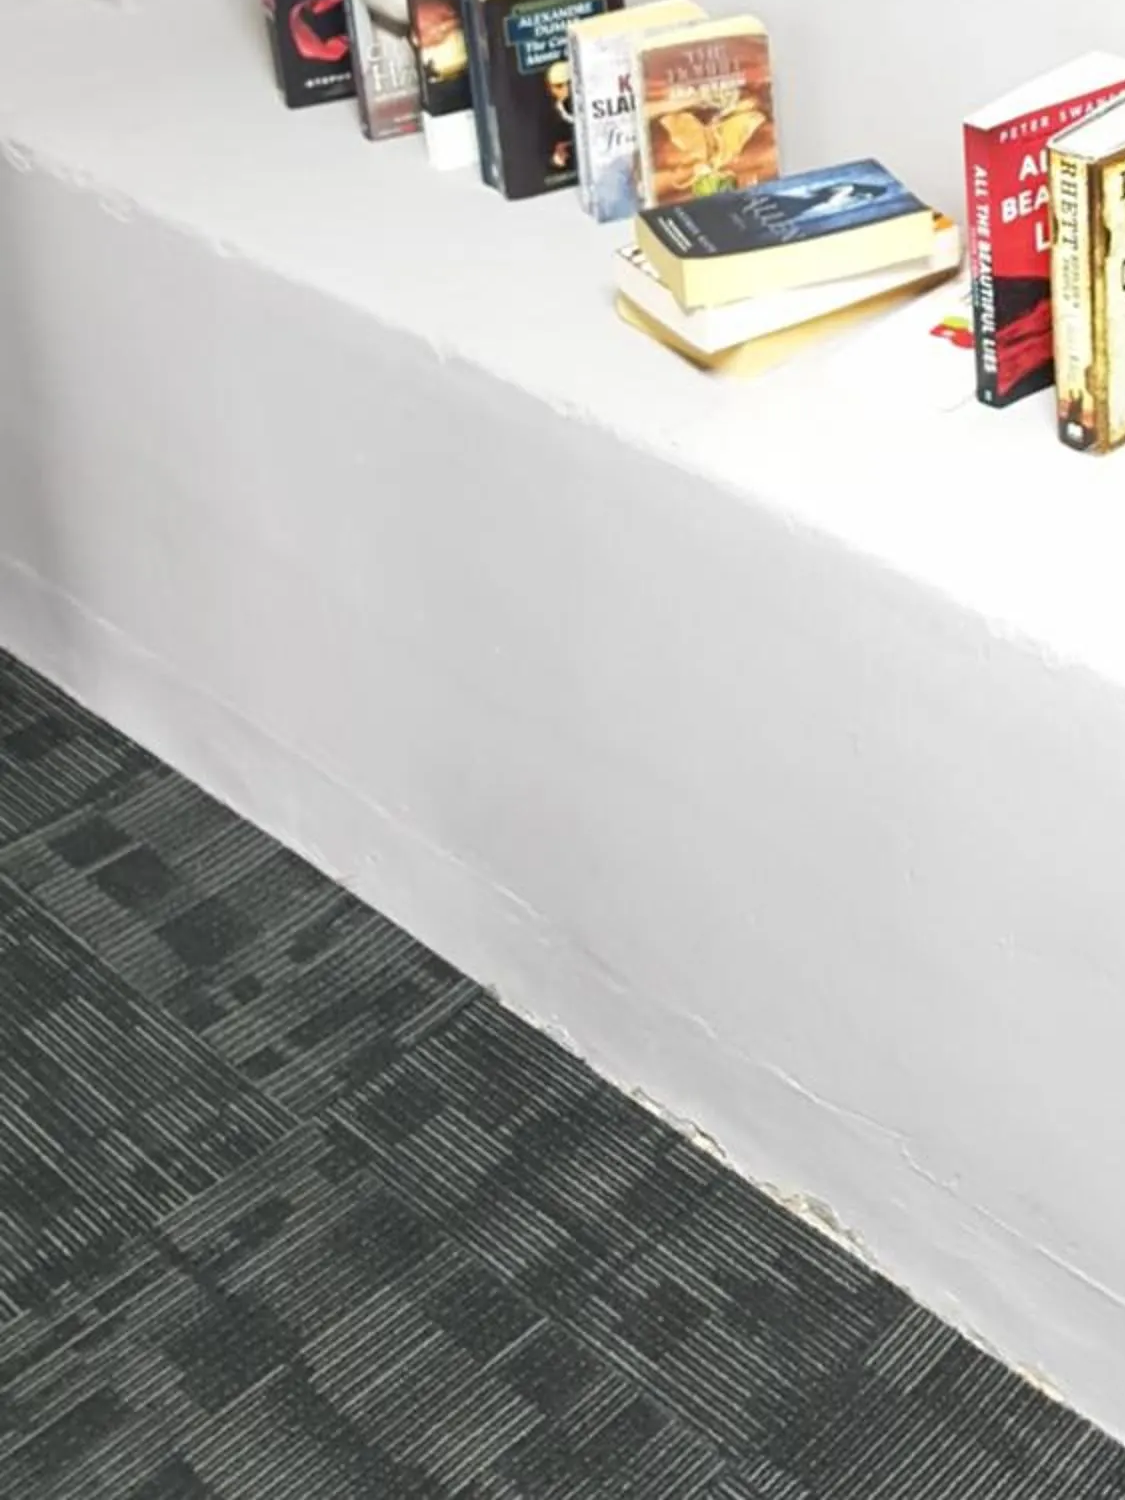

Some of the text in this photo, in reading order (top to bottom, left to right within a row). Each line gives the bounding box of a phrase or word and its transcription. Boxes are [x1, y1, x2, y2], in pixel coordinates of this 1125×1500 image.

[1000, 115, 1050, 144] PETER
[1060, 159, 1080, 252] RHETT
[973, 163, 998, 373] ALL THE BEAUTIFUL LIES
